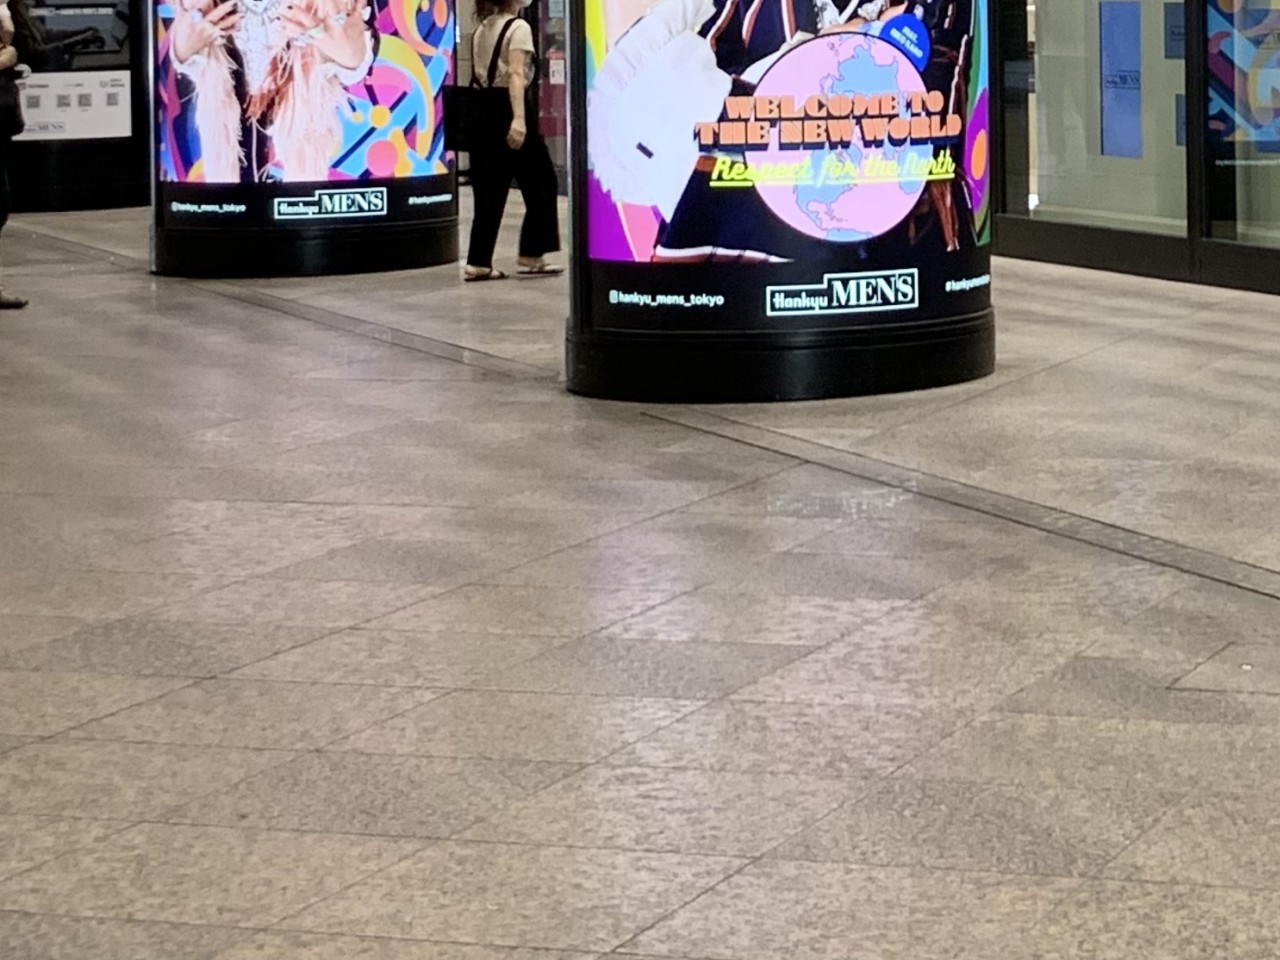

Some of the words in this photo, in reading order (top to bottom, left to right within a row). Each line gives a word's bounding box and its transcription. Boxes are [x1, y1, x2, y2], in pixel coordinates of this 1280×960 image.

[724, 91, 899, 119] WELCOME
[906, 90, 944, 114] TO
[695, 120, 770, 145] THE
[779, 118, 856, 144] NEW
[861, 114, 962, 141] WORLD
[863, 152, 899, 177] the
